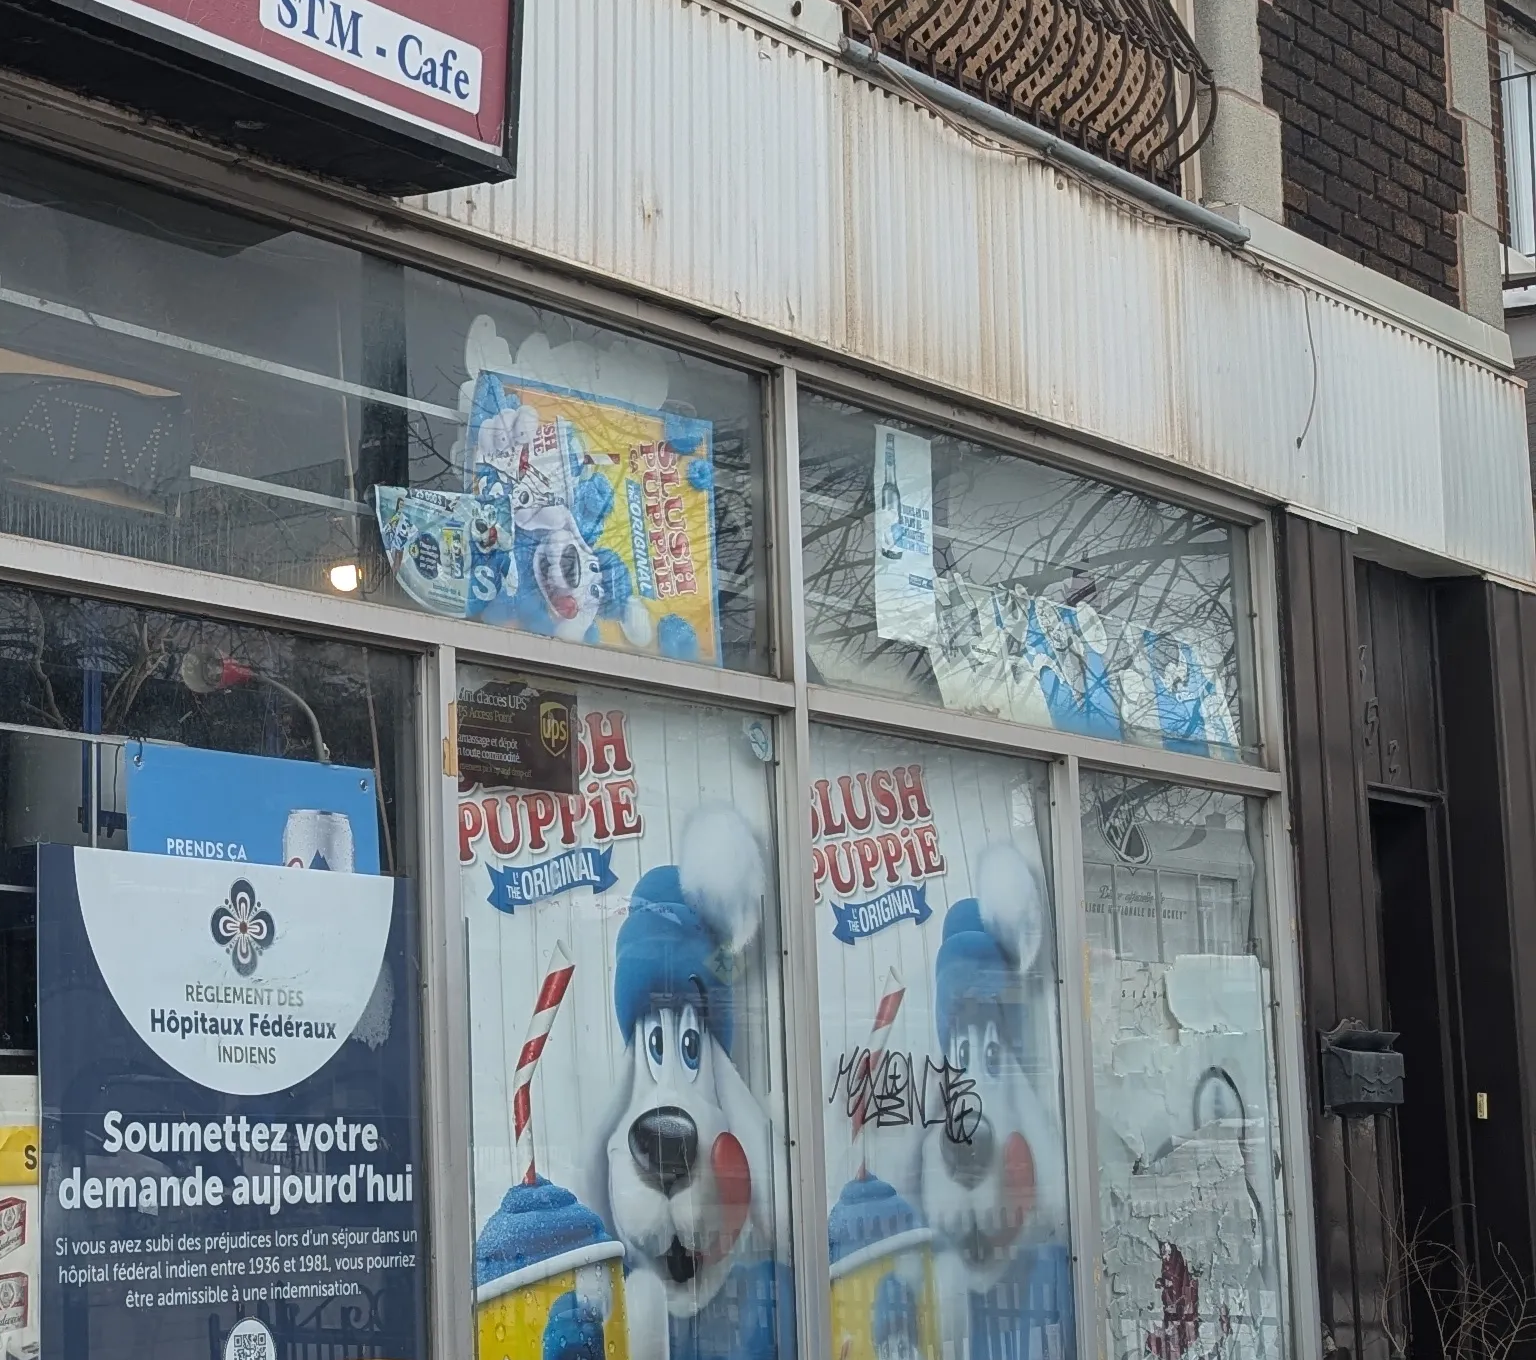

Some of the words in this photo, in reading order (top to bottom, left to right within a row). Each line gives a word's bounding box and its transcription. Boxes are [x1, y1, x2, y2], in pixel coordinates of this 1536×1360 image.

[10, 392, 162, 478] ATM
[630, 503, 652, 592] ORIGINAL
[543, 717, 567, 747] ups
[166, 838, 224, 859] PRENDS
[521, 853, 601, 901] ORIGINAL
[859, 888, 921, 933] ORIGINAL
[185, 982, 274, 1007] RÈGLEMENT
[277, 987, 304, 1007] DES
[150, 1009, 244, 1040] Hôpitaux
[249, 1012, 337, 1040] Fédéraux
[217, 1045, 277, 1065] INDIENS
[103, 1110, 287, 1153] Soumettez
[295, 1117, 378, 1152] votre
[58, 1166, 223, 1209] demande
[232, 1163, 413, 1215] aujourd'hui
[56, 1238, 67, 1256] Si
[72, 1240, 105, 1255] vous
[110, 1240, 141, 1253] avez
[146, 1234, 173, 1252] subi
[178, 1234, 201, 1251] des
[205, 1231, 271, 1254] préjudices
[275, 1230, 298, 1247] lors
[302, 1229, 328, 1246] d'un
[332, 1228, 369, 1249] séjour
[372, 1227, 399, 1243] dans
[403, 1230, 417, 1242] un
[58, 1264, 109, 1287] hôpital
[113, 1261, 162, 1281] fédéral
[166, 1259, 207, 1278] indien
[211, 1260, 245, 1276] entre
[249, 1256, 280, 1274] 1936
[284, 1260, 296, 1273] et
[299, 1254, 332, 1272] 1981,
[335, 1257, 364, 1270] vous
[367, 1252, 416, 1273] pourriez
[126, 1290, 154, 1308] être
[158, 1286, 229, 1306] admissible
[232, 1285, 239, 1302] à
[243, 1287, 267, 1301] une
[271, 1280, 362, 1299] indemnisation.
